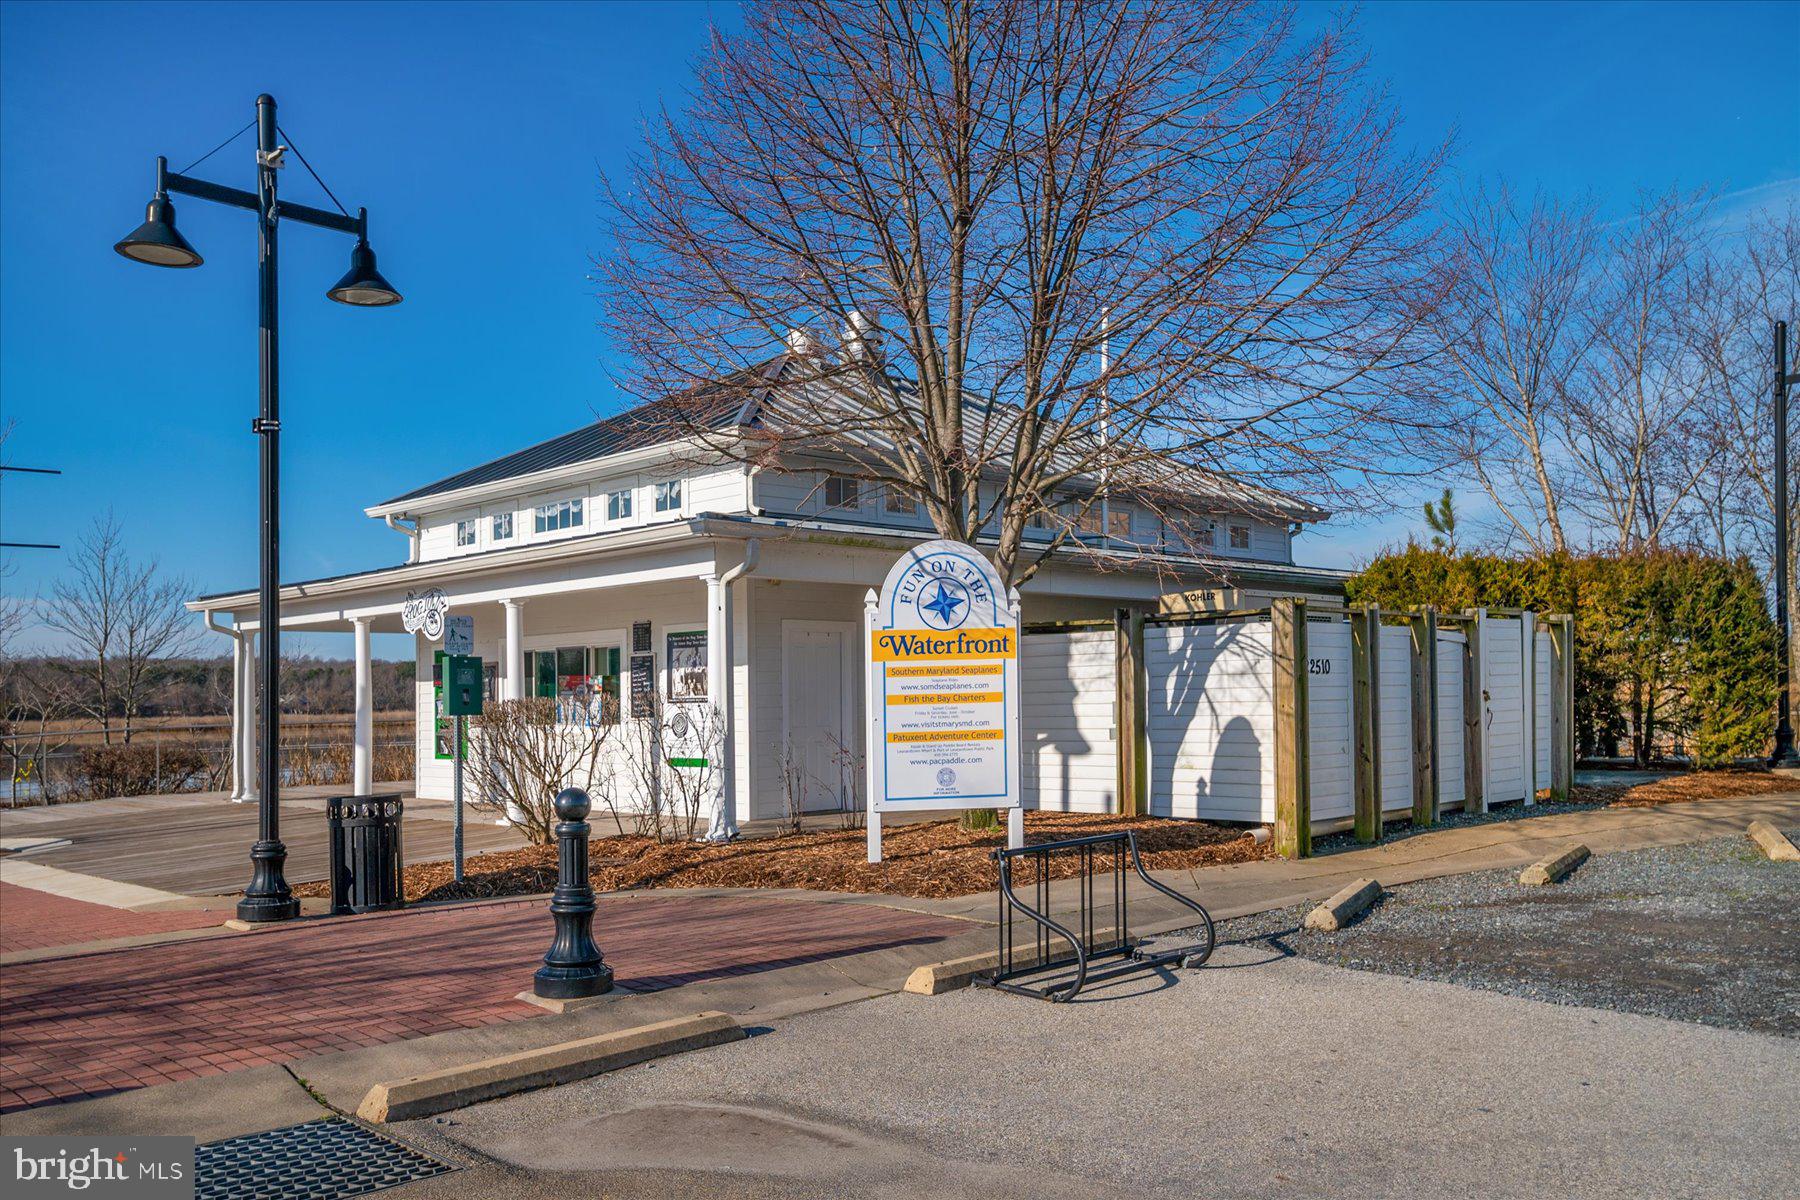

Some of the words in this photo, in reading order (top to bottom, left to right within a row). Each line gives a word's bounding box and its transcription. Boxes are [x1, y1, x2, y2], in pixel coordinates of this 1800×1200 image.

[900, 569, 926, 605] FUN
[931, 560, 956, 573] ON
[962, 568, 988, 604] THE
[1184, 593, 1216, 602] KOHLER
[879, 632, 1010, 656] Waterfront
[891, 667, 924, 676] Southern
[926, 666, 960, 676] Maryland
[962, 665, 998, 675] Seaplanes
[1307, 659, 1331, 675] 2510
[900, 682, 990, 691] www.somdseaplanes.com
[904, 695, 920, 703] Fish
[922, 694, 935, 702] the
[937, 694, 951, 704] Bay
[953, 693, 986, 702] Charters
[900, 719, 990, 730] www.visitstmarysmd.com
[893, 733, 928, 742] Patuxent
[930, 732, 969, 741] Adventure
[970, 731, 998, 740] Center
[909, 756, 983, 766] www.pacpaddle.com
